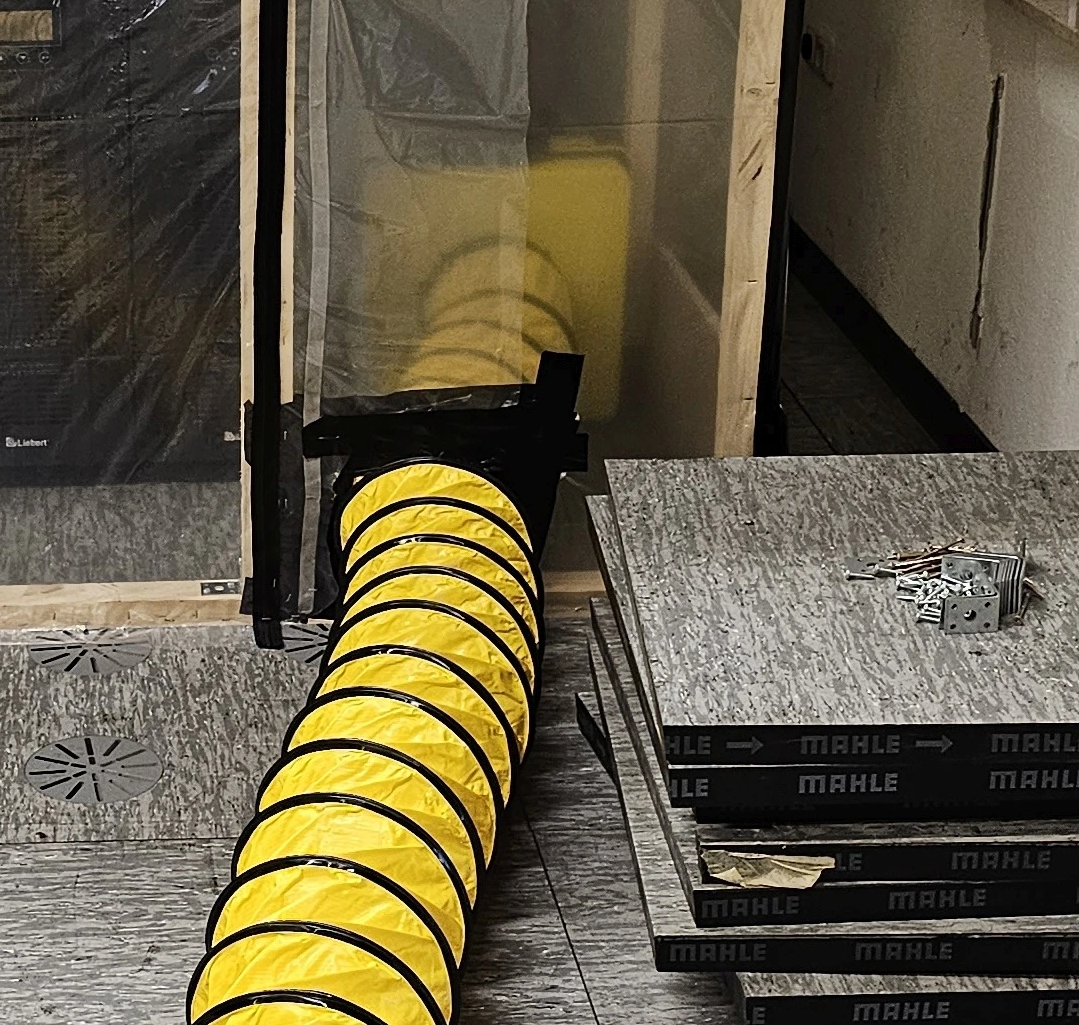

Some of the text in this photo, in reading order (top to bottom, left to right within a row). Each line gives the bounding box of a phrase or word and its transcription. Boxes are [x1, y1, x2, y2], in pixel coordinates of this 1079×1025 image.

[665, 733, 1079, 756] HLE MAHLE MAHL
[798, 769, 1079, 794] MAHLE MAHL
[951, 850, 1051, 870] MAHLE
[701, 889, 987, 919] MAHLE MAHLE
[670, 942, 953, 962] MAHLE MAHLE
[852, 1001, 950, 1022] MAHLE
